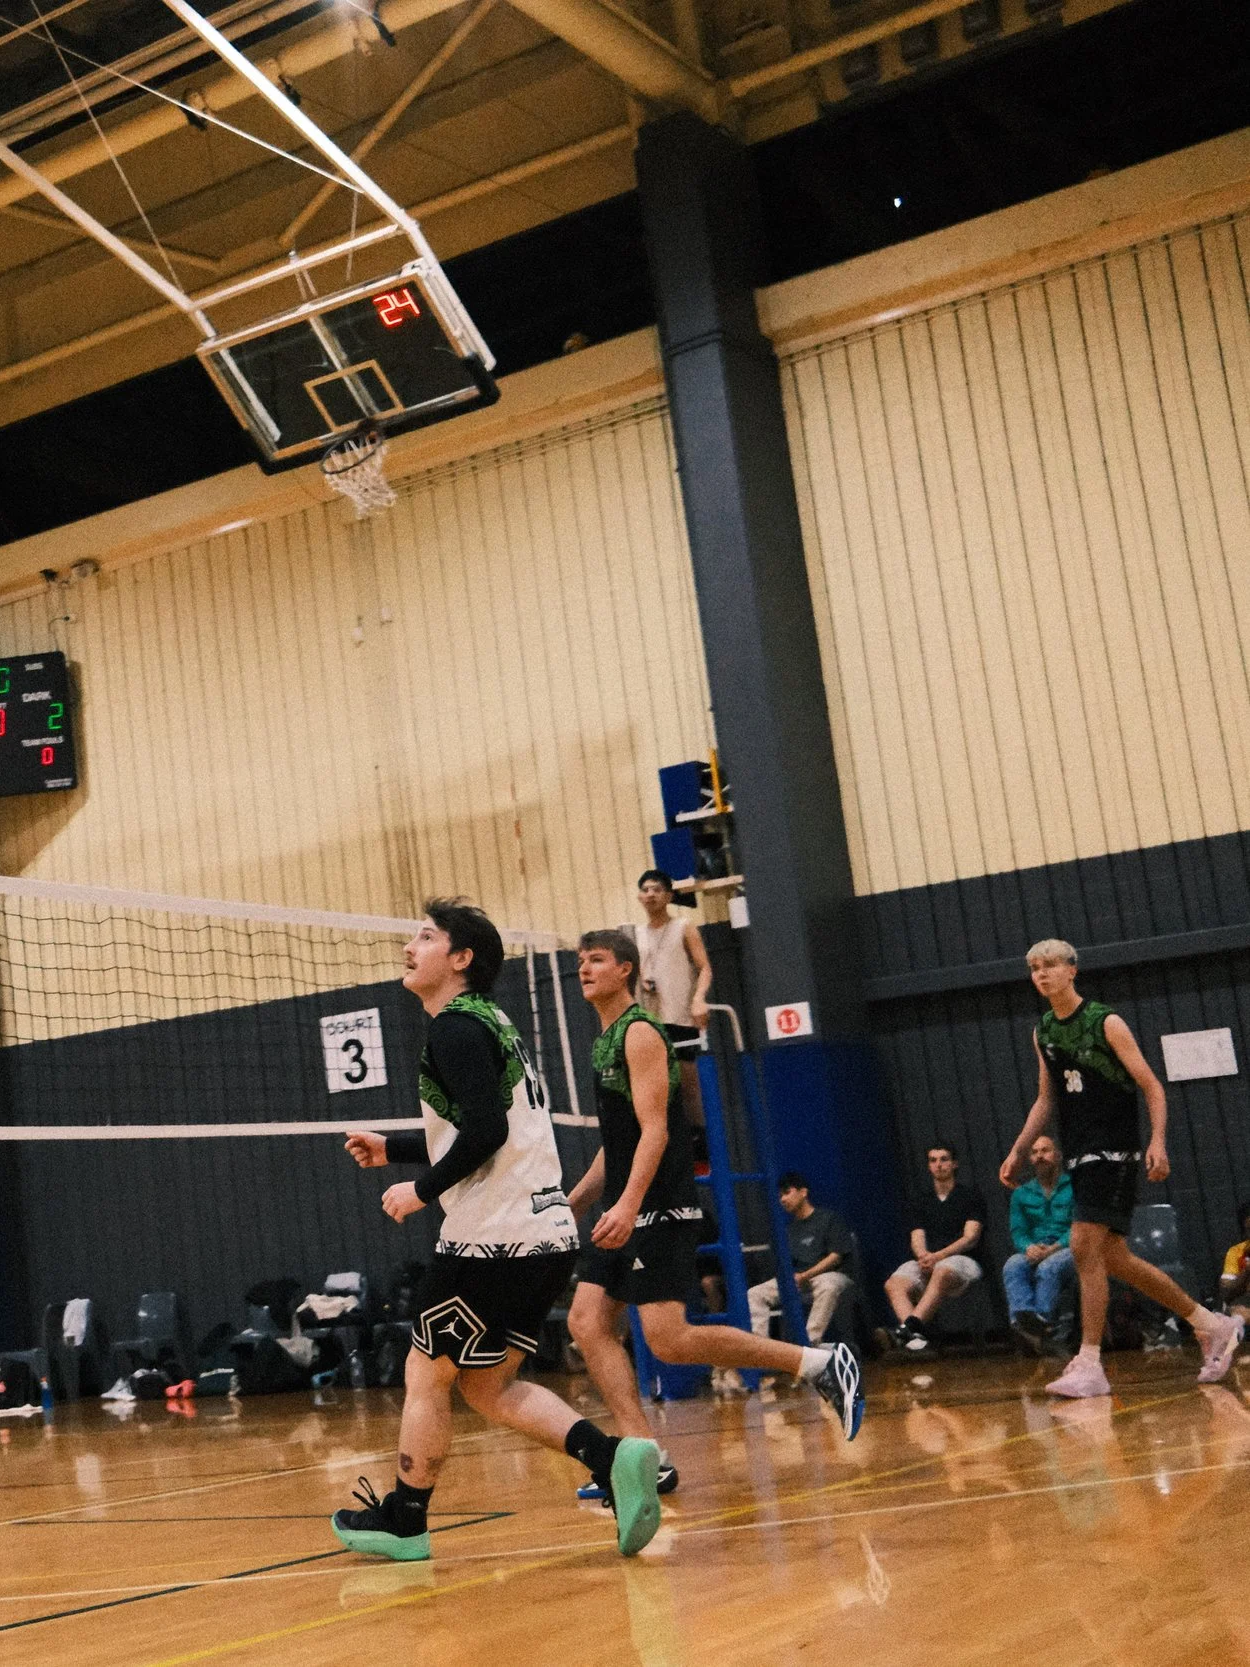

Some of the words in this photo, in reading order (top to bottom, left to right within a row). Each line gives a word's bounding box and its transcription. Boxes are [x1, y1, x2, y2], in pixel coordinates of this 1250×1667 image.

[372, 288, 421, 327] 24
[21, 691, 52, 702] DARK
[47, 702, 64, 730] 2
[41, 747, 54, 765] 0
[341, 1038, 368, 1084] 3
